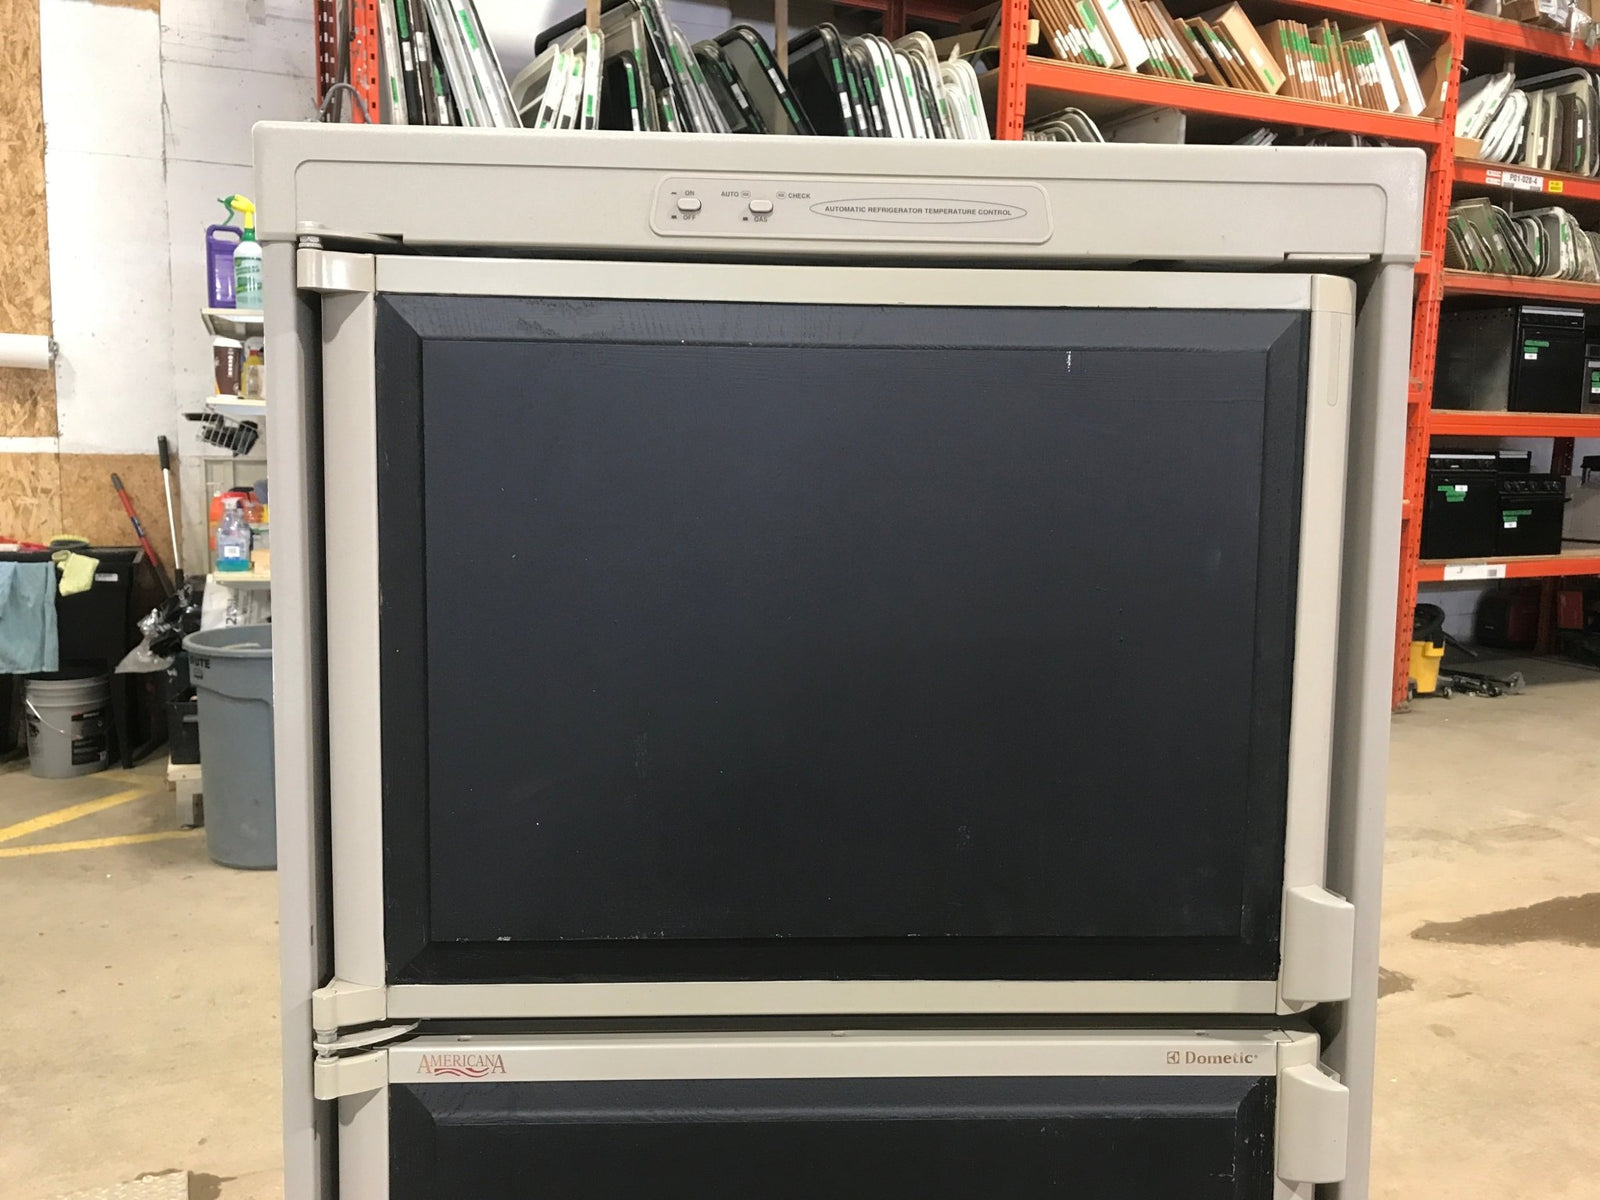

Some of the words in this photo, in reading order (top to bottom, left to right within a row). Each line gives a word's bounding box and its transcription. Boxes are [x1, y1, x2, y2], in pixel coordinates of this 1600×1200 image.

[824, 205, 867, 214] AUTOMATIC
[867, 206, 923, 215] REFRIGERATOR
[924, 207, 977, 216] TEMPERATURE
[978, 208, 1012, 216] CONTROL
[753, 215, 768, 223] GAS
[417, 1053, 507, 1074] AMERICANA
[1185, 1051, 1254, 1064] Dometic
